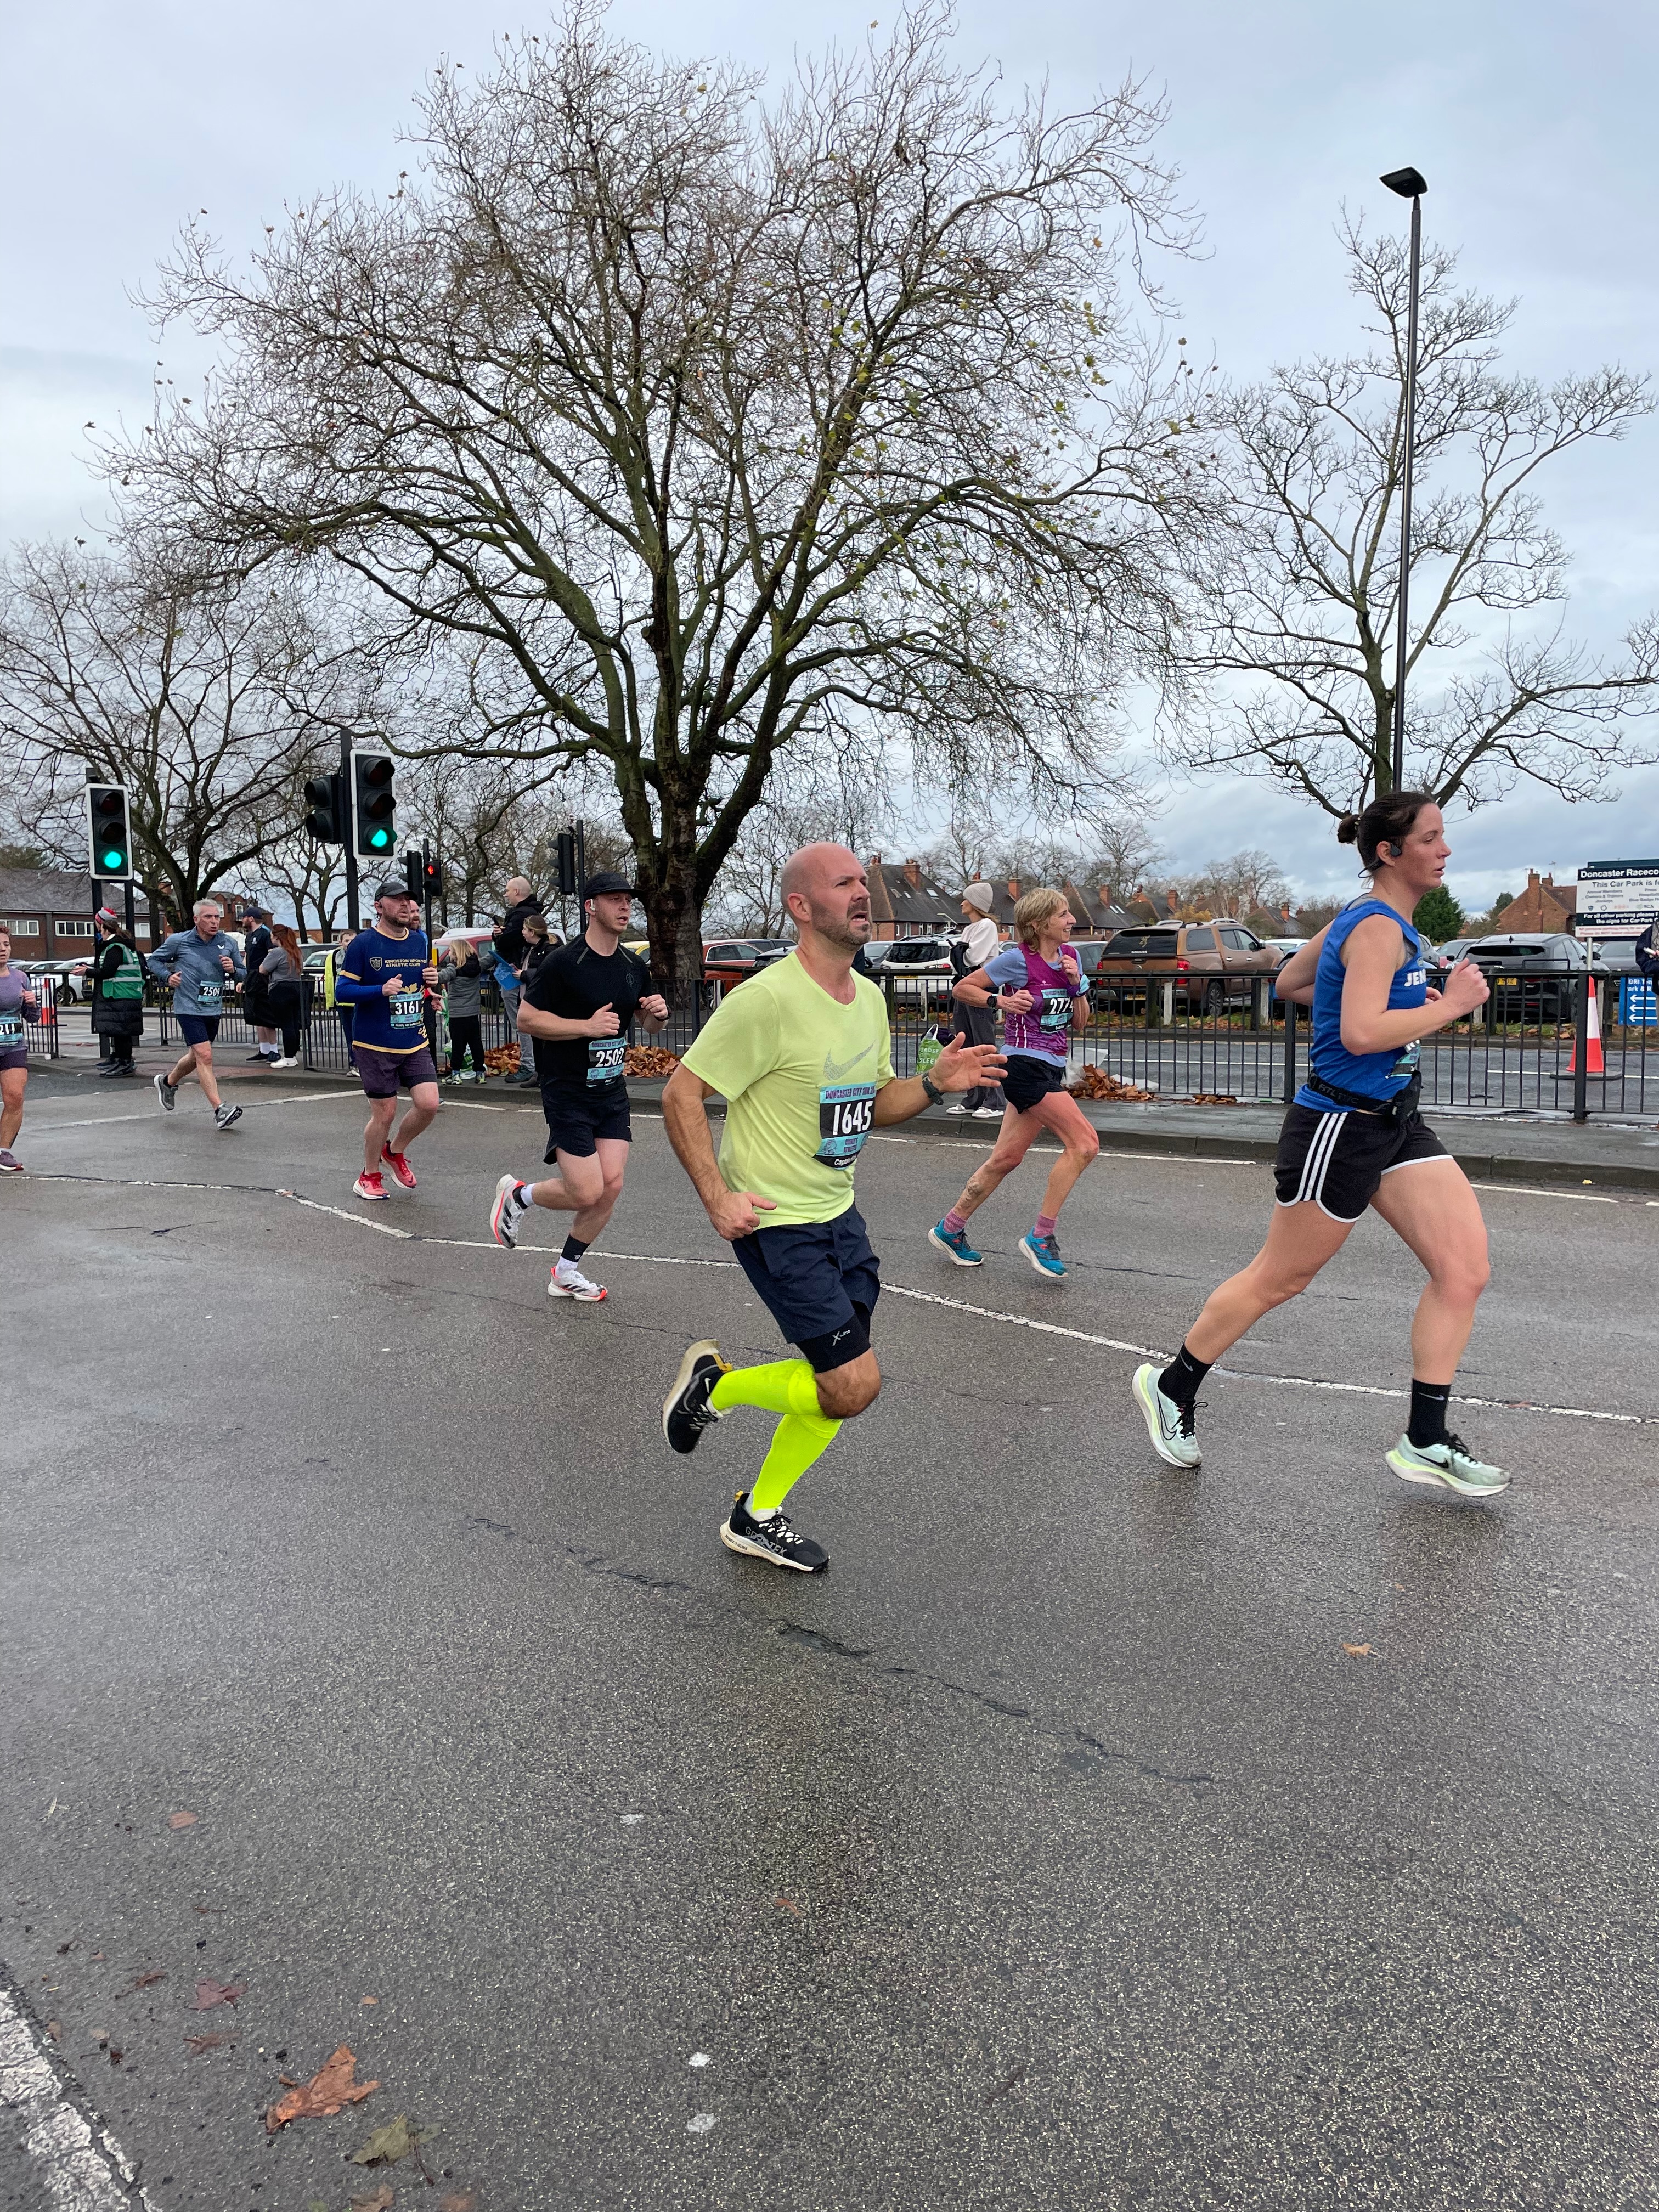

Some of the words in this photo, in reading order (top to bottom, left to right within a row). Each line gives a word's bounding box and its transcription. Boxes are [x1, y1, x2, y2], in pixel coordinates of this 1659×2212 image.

[395, 1000, 419, 1015] 3161
[595, 1047, 624, 1068] 2502
[826, 1088, 852, 1099] DONCASTER
[853, 1087, 862, 1096] CITY
[833, 1101, 873, 1136] 1645
